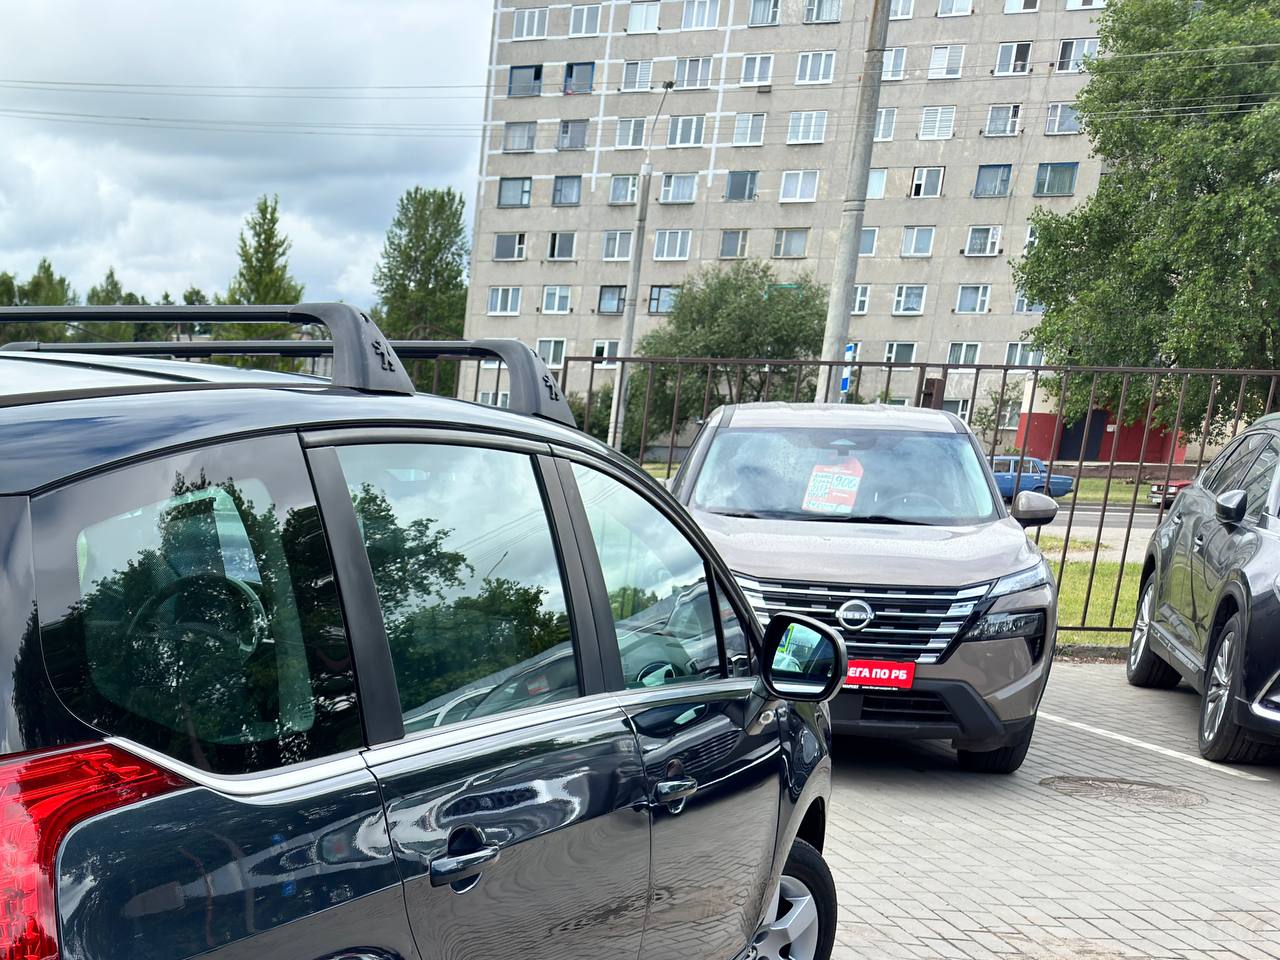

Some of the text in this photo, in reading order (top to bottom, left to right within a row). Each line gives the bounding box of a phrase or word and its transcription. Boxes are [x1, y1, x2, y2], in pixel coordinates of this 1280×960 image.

[835, 610, 875, 620] NISSAN
[848, 667, 907, 680] ЕГА ПО РБ
